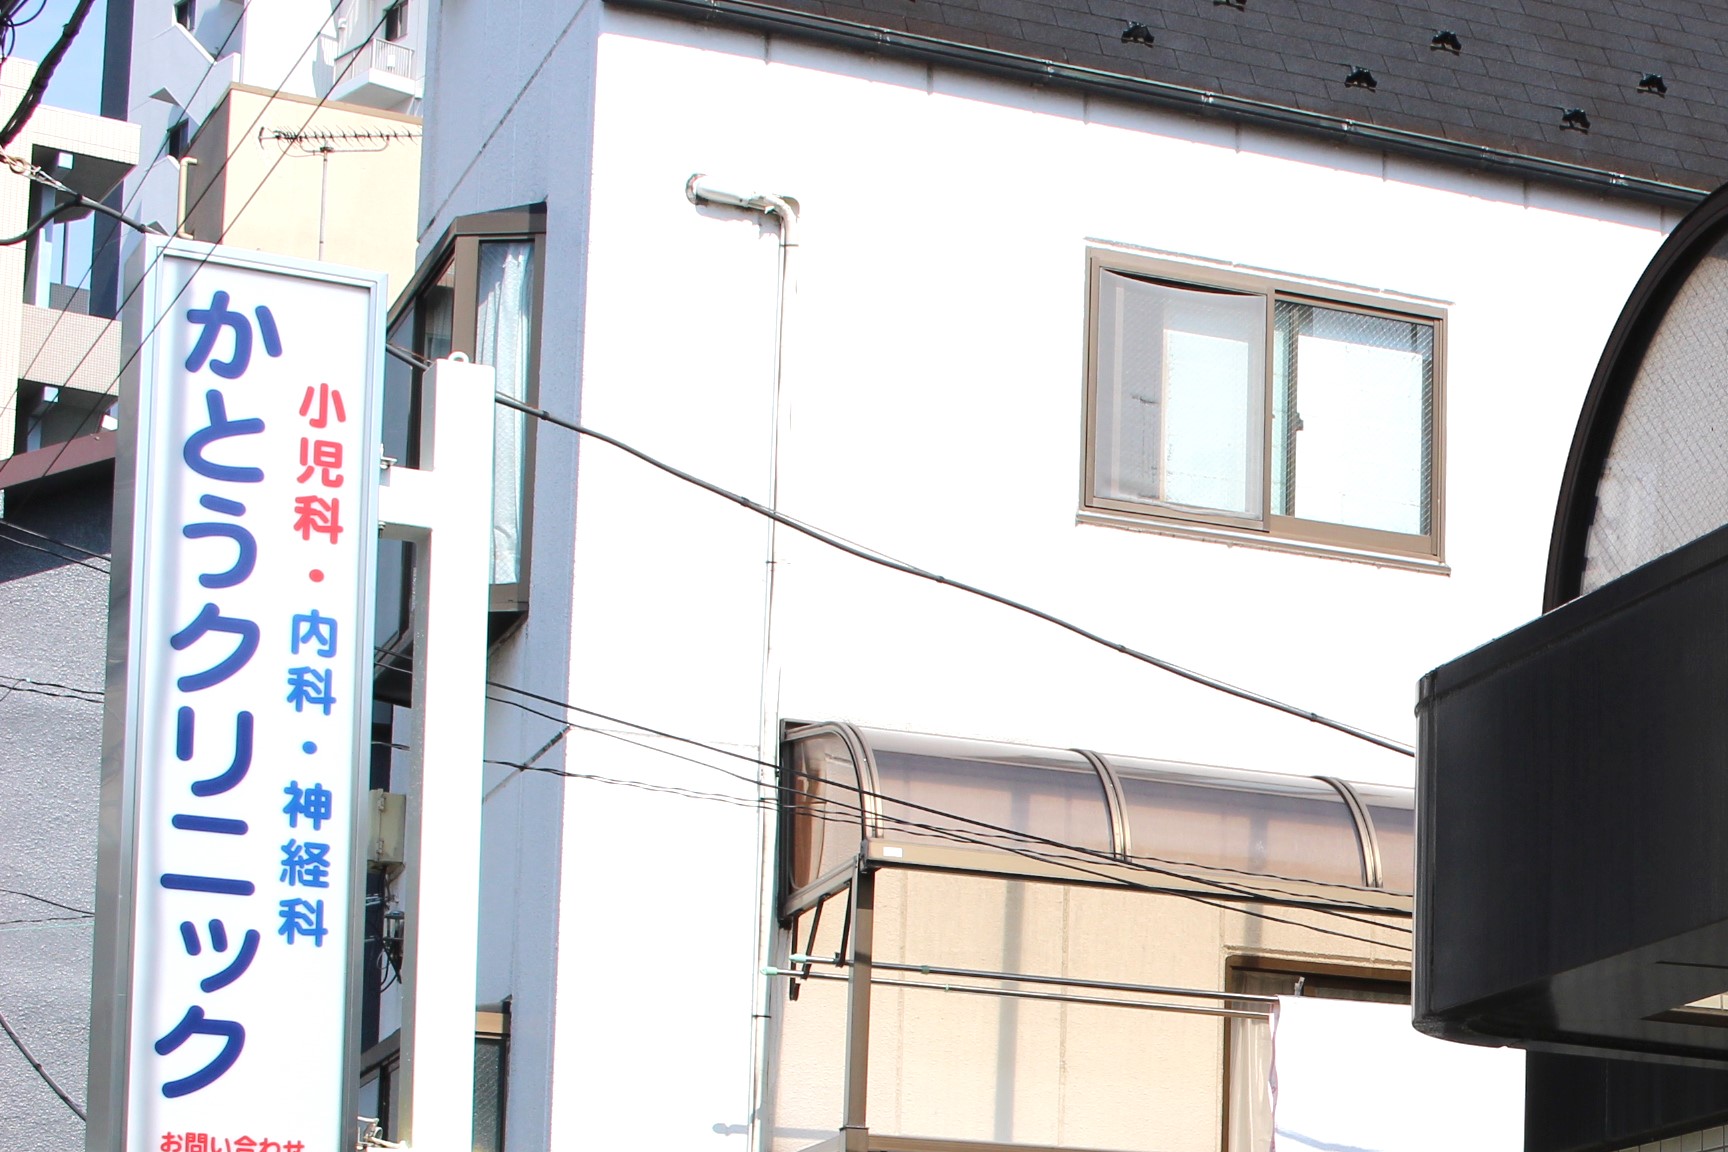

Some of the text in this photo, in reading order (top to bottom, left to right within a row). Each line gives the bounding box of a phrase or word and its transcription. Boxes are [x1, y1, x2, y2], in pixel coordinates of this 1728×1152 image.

[155, 291, 282, 1098] かとうクリニック
